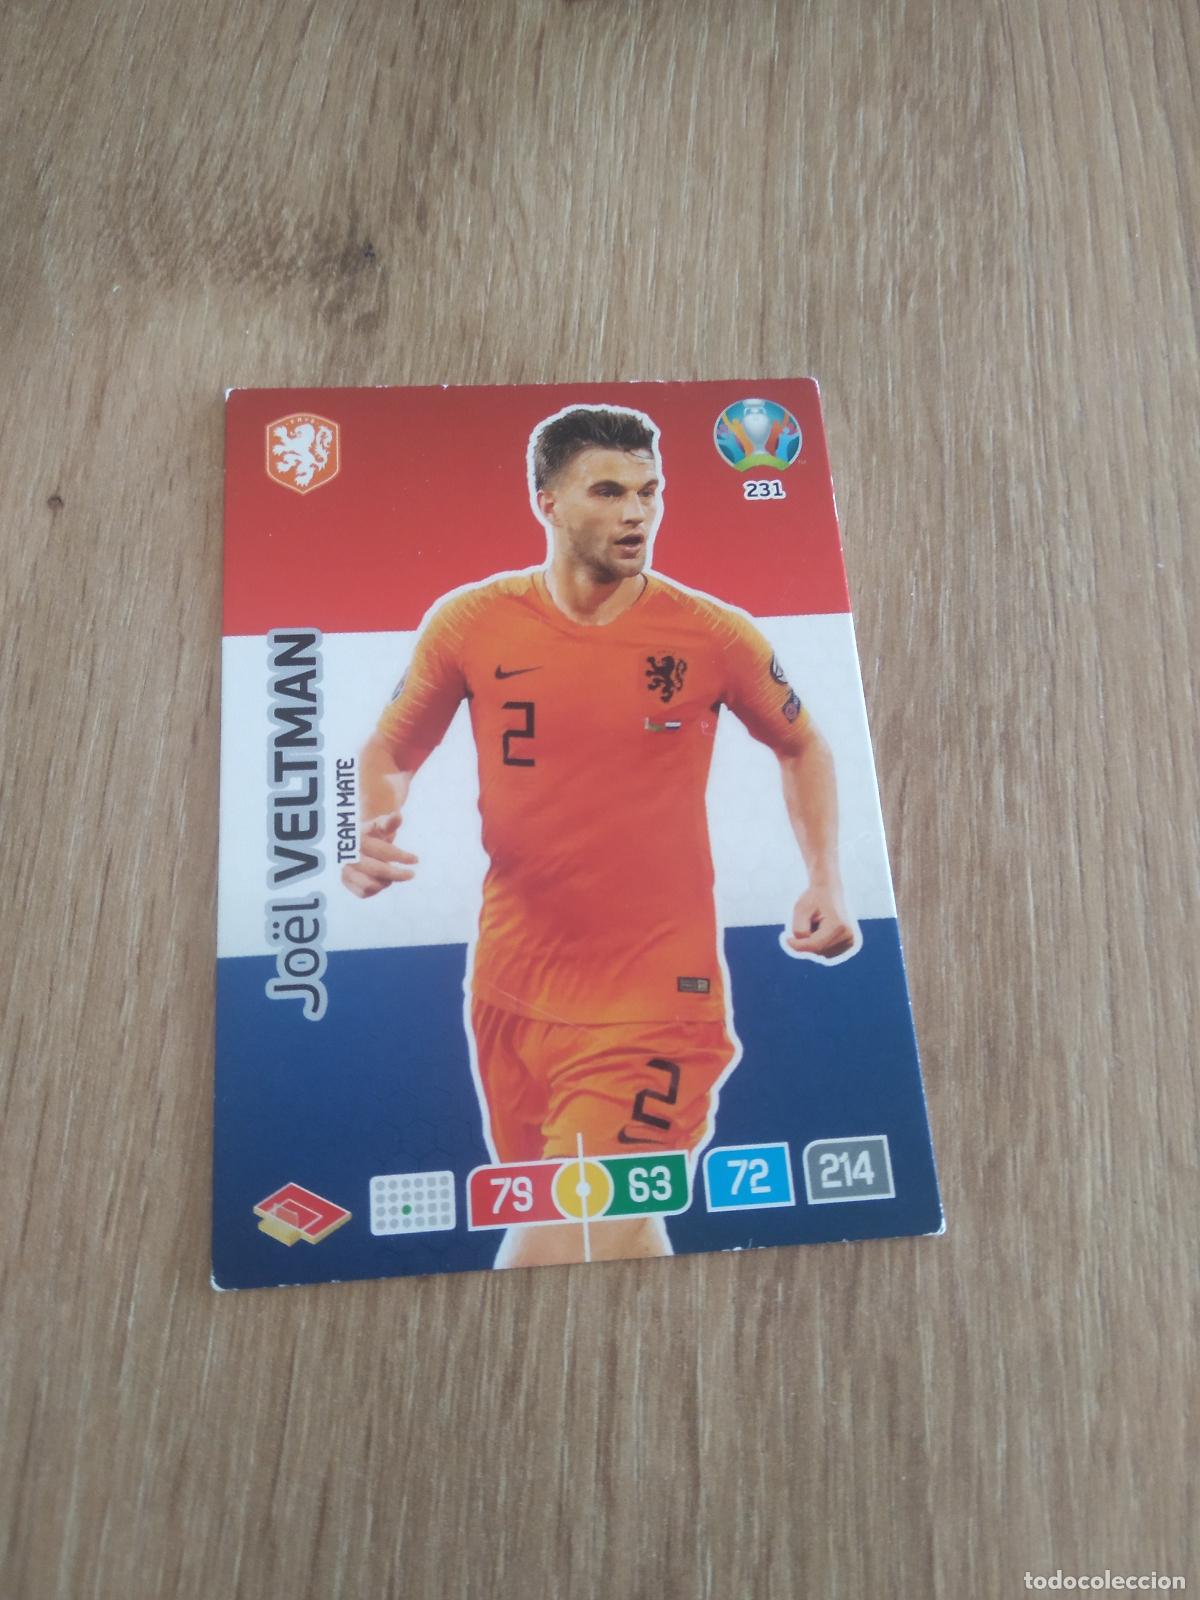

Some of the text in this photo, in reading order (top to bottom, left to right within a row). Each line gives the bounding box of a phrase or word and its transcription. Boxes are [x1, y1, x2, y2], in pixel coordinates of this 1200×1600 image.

[746, 482, 783, 497] 231
[502, 701, 535, 767] 2
[271, 632, 320, 1014] Joël VELTMAN
[336, 758, 357, 864] TEAM MATE
[632, 1057, 680, 1130] 2
[628, 1165, 673, 1203] 63
[726, 1157, 771, 1195] 72
[818, 1150, 875, 1191] 214
